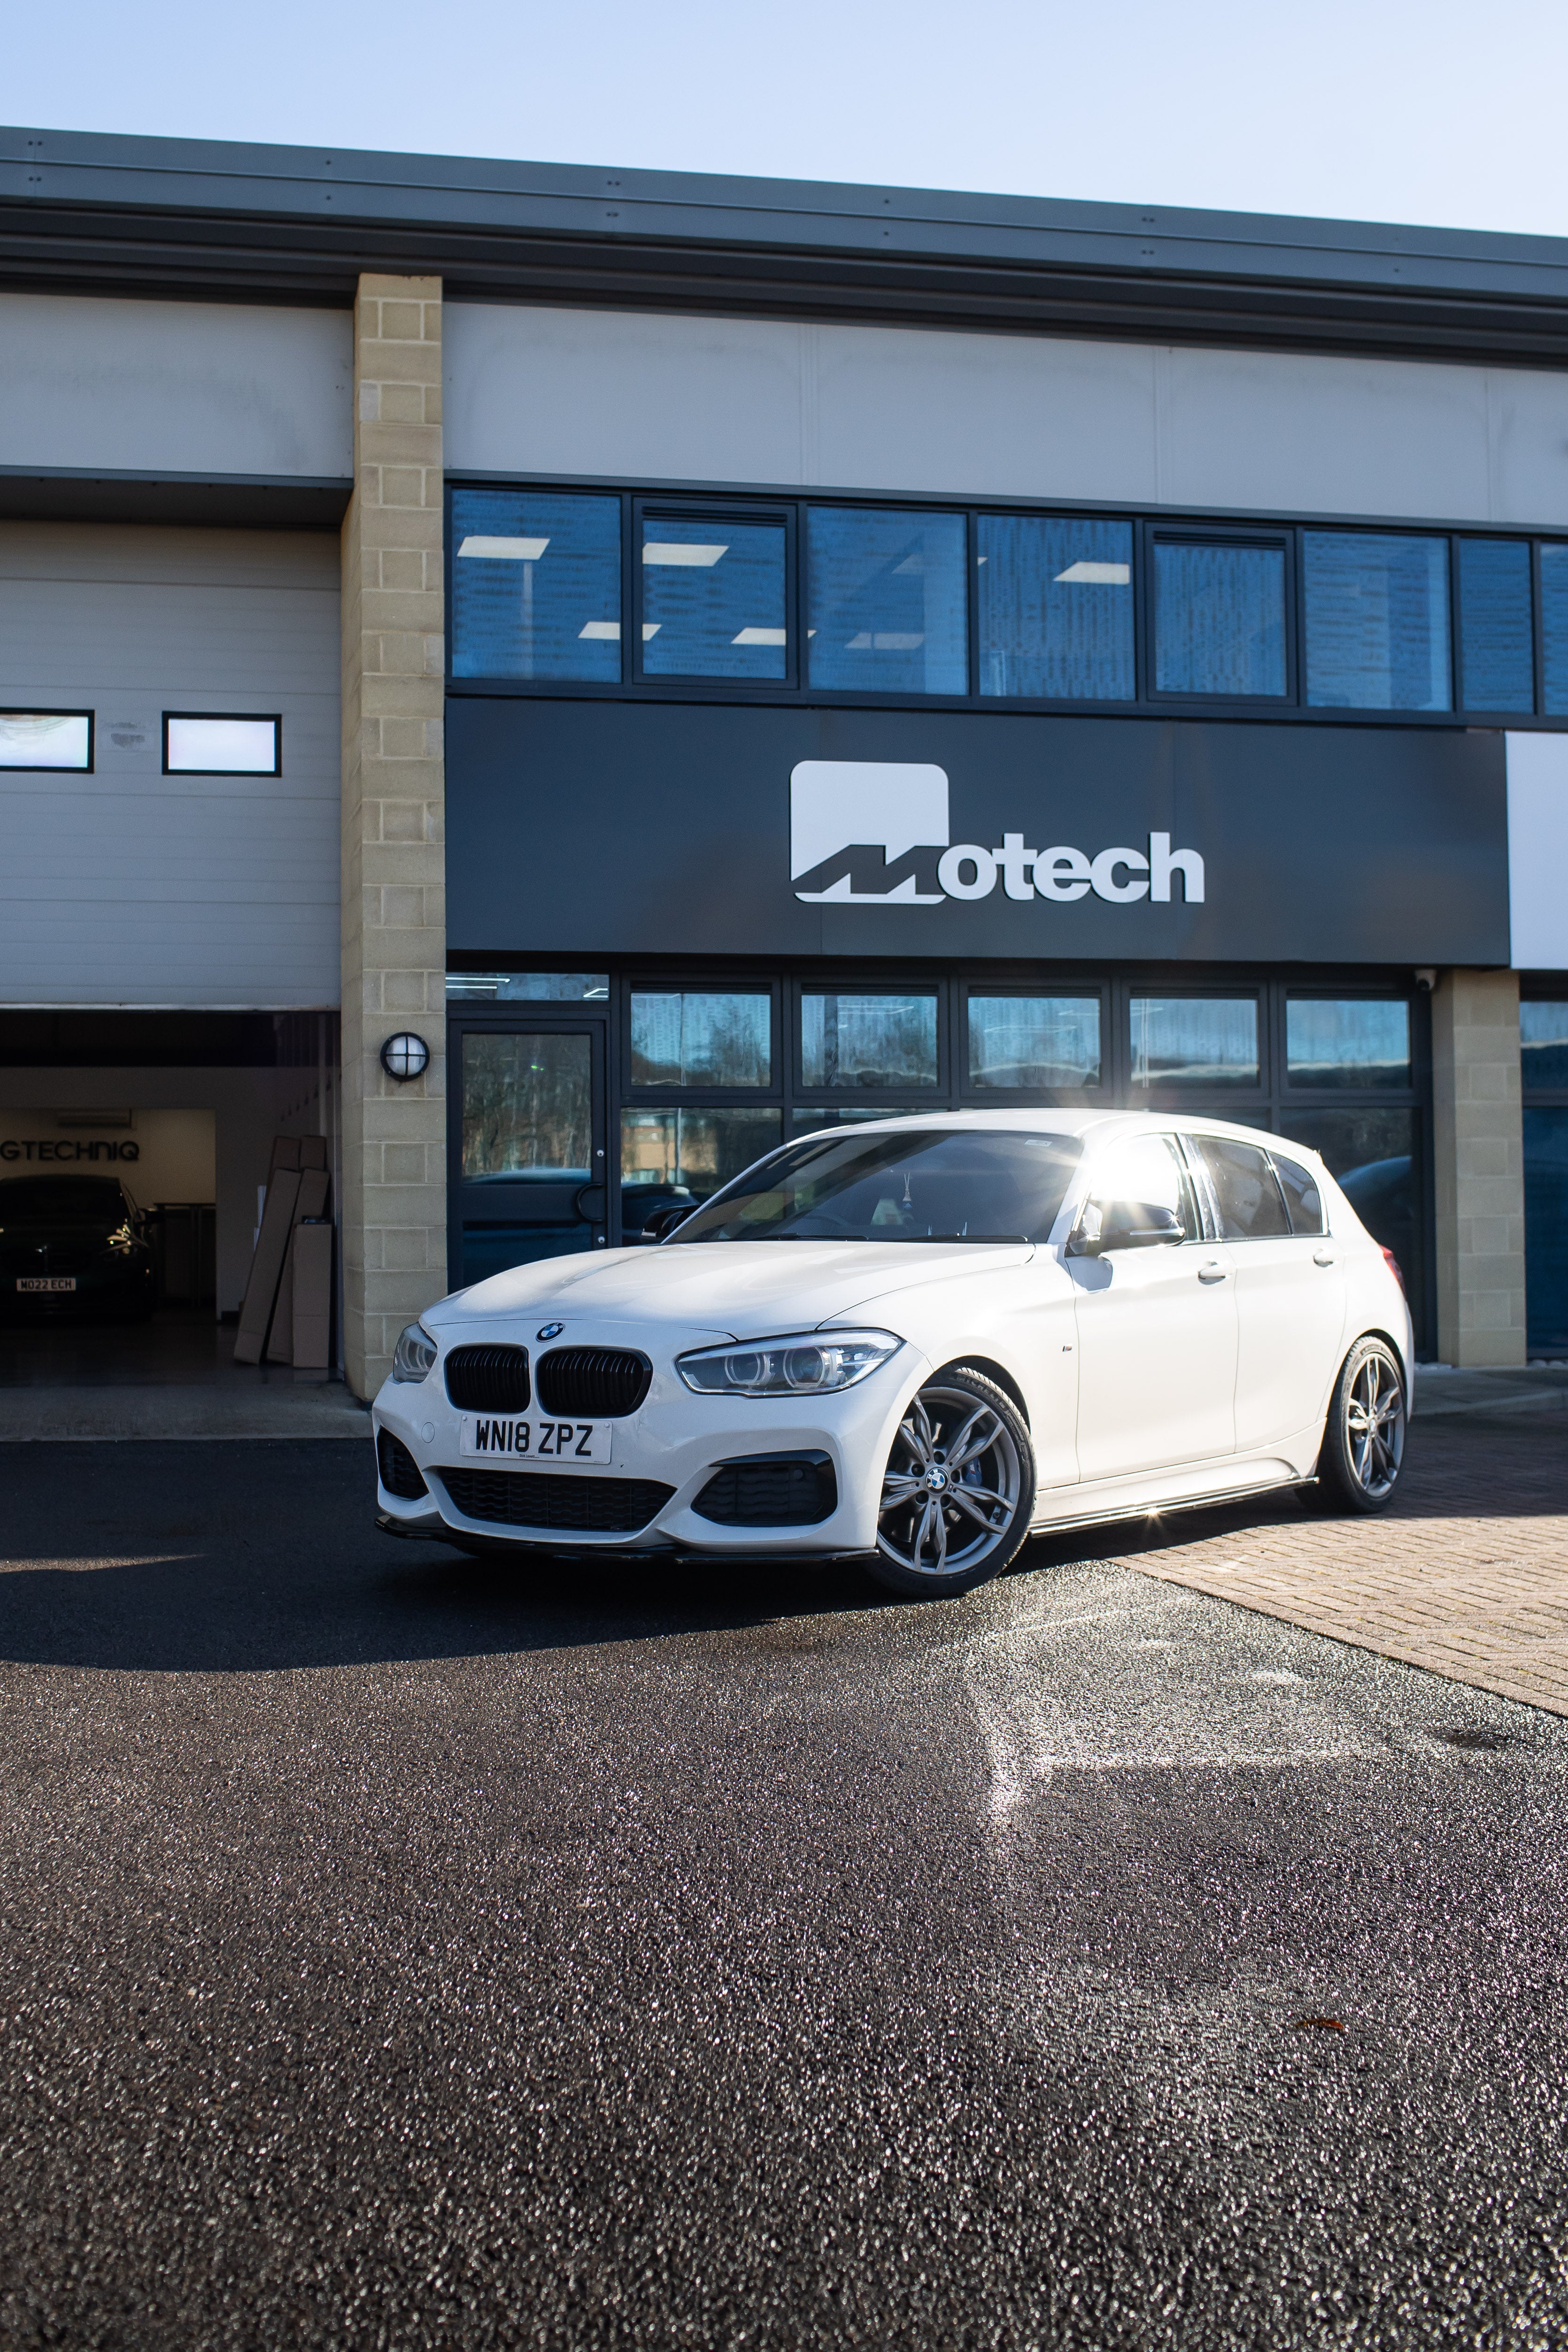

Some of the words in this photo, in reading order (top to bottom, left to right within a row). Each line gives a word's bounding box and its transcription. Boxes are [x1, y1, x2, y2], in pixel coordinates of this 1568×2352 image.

[0, 1140, 139, 1161] GTECHNIQ
[476, 1419, 530, 1453] WN18
[538, 1422, 593, 1456] ZPZ
